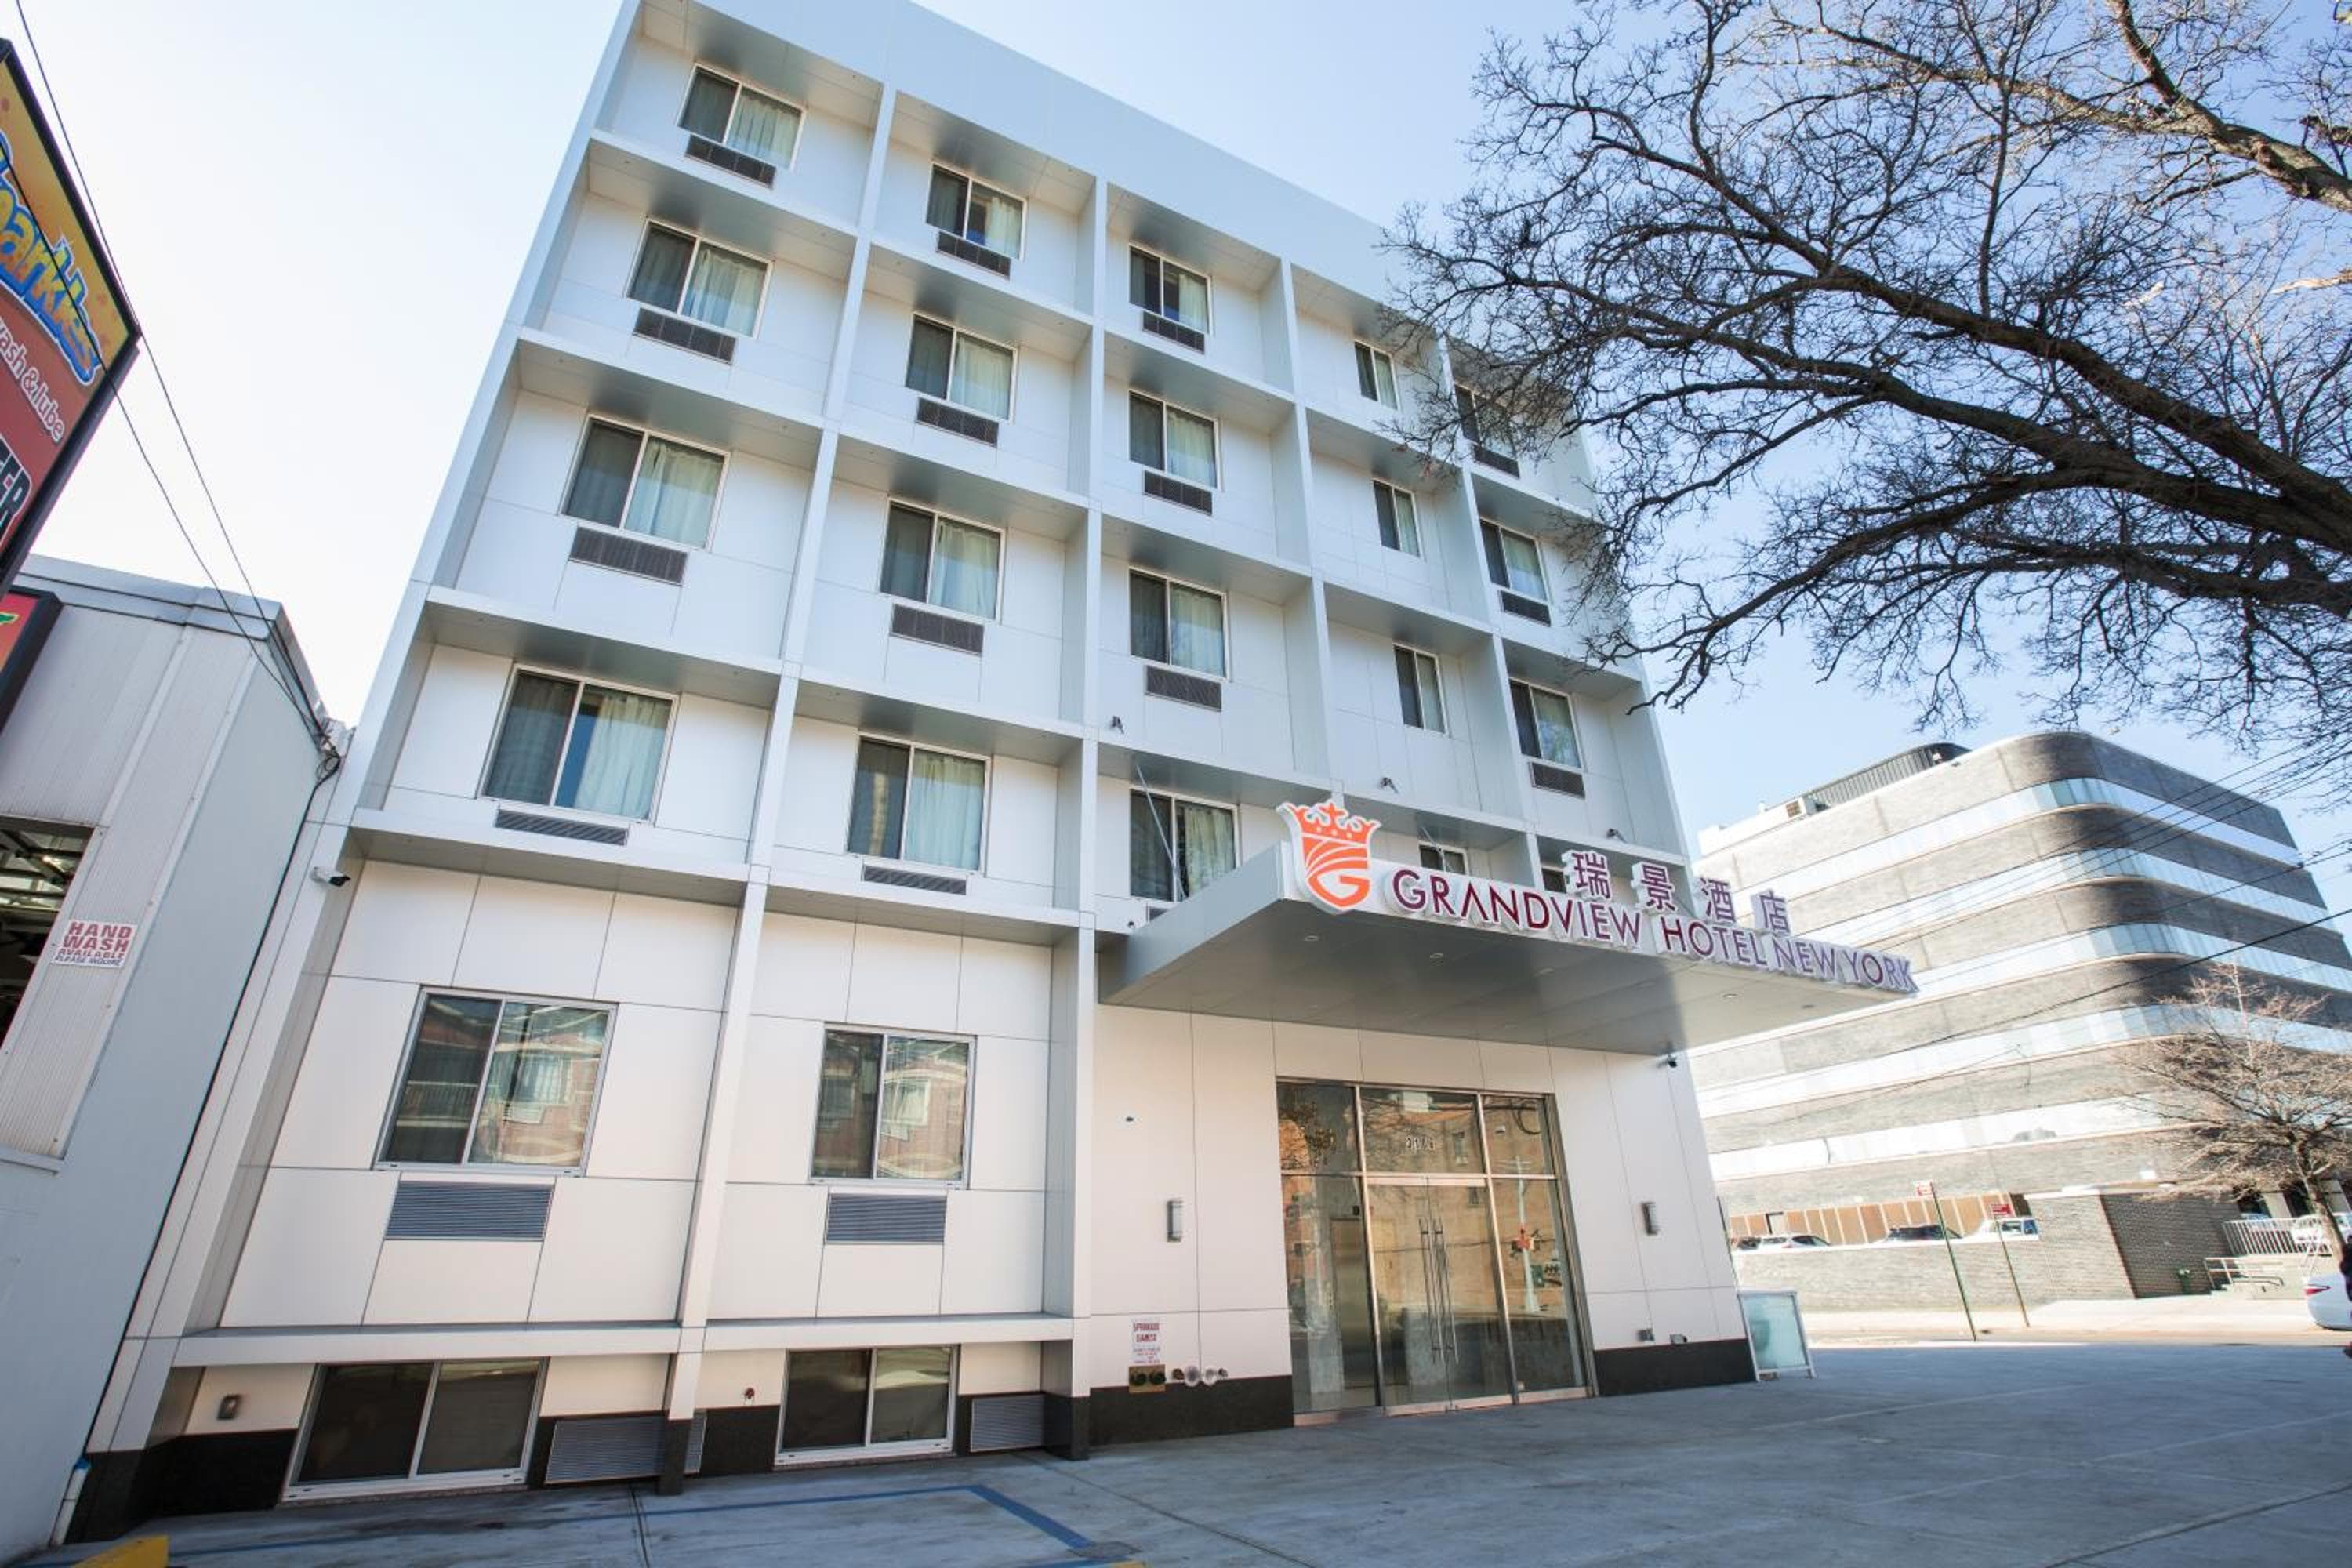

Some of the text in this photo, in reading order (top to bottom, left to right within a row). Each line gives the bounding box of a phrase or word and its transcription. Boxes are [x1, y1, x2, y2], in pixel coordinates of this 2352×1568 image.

[0, 316, 27, 379] ash
[1570, 851, 1791, 935] 瑞景酒店
[63, 935, 129, 953] WASH
[68, 921, 132, 938] HAND
[1392, 868, 1919, 992] GRANDVIEW HOTEL NEW YORK
[58, 948, 125, 959] AVAILABLE
